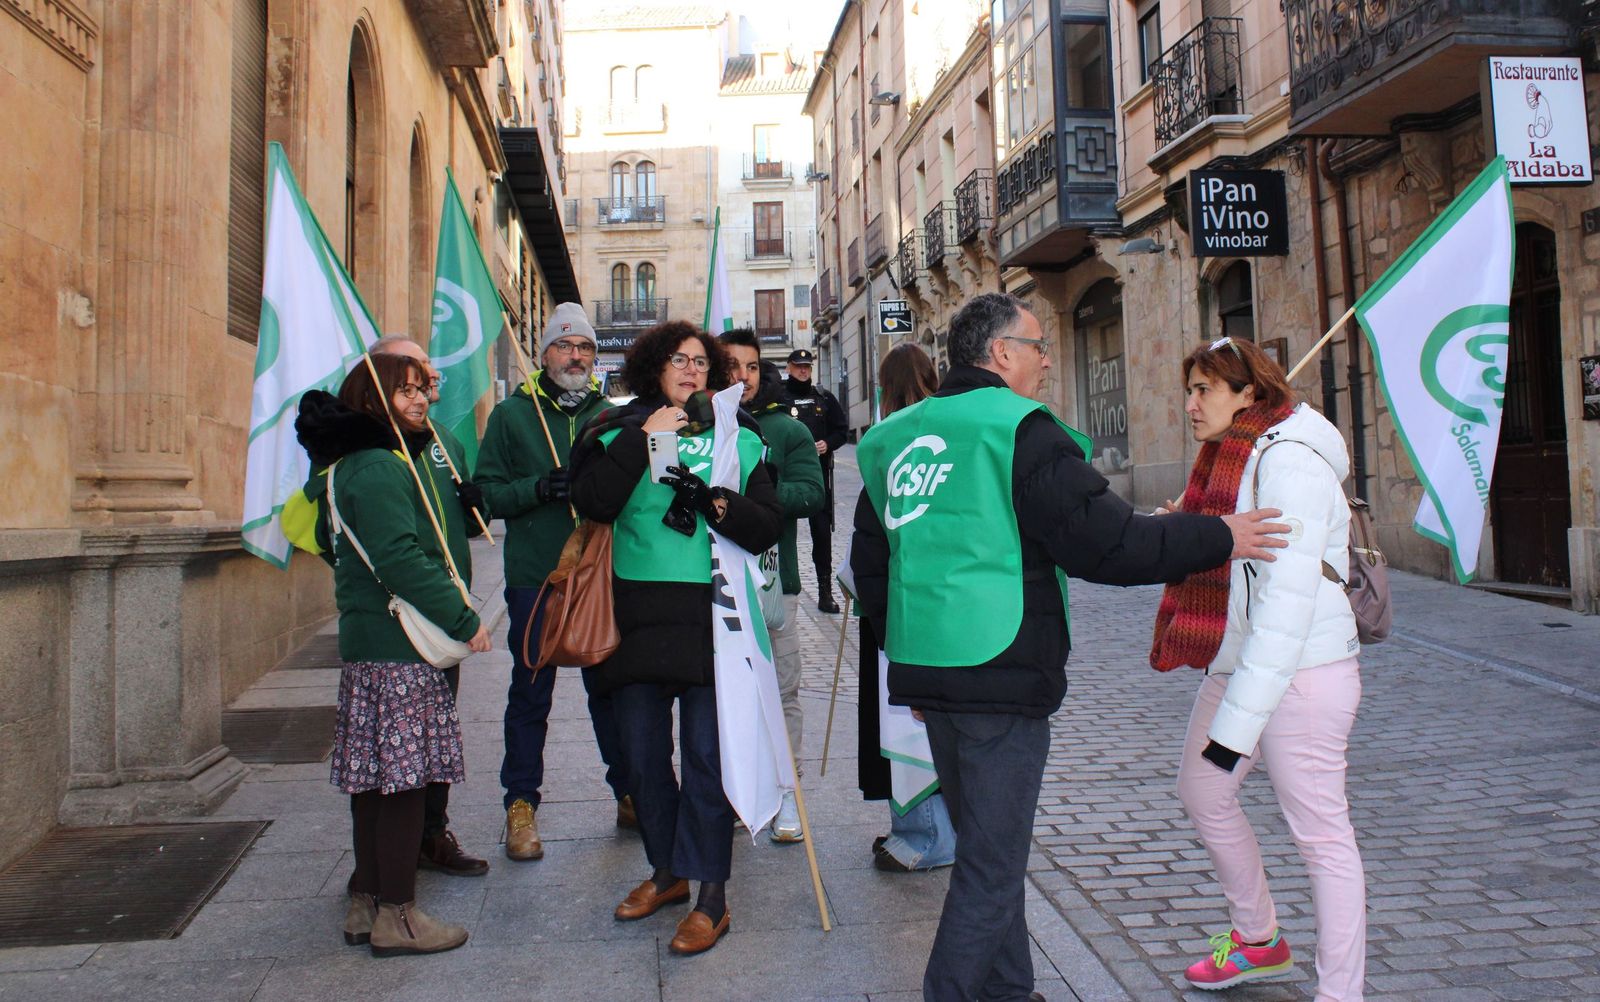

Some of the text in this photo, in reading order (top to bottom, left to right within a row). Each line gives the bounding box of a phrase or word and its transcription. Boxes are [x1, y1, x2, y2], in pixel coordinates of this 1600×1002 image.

[1493, 61, 1579, 81] Restaurante
[1528, 141, 1557, 158] La
[1200, 177, 1257, 202] iPan
[1202, 205, 1269, 230] iVino
[1204, 231, 1269, 249] vinobar
[1088, 355, 1120, 396] iPan
[1090, 397, 1127, 439] iVino
[891, 462, 954, 498] CSIF
